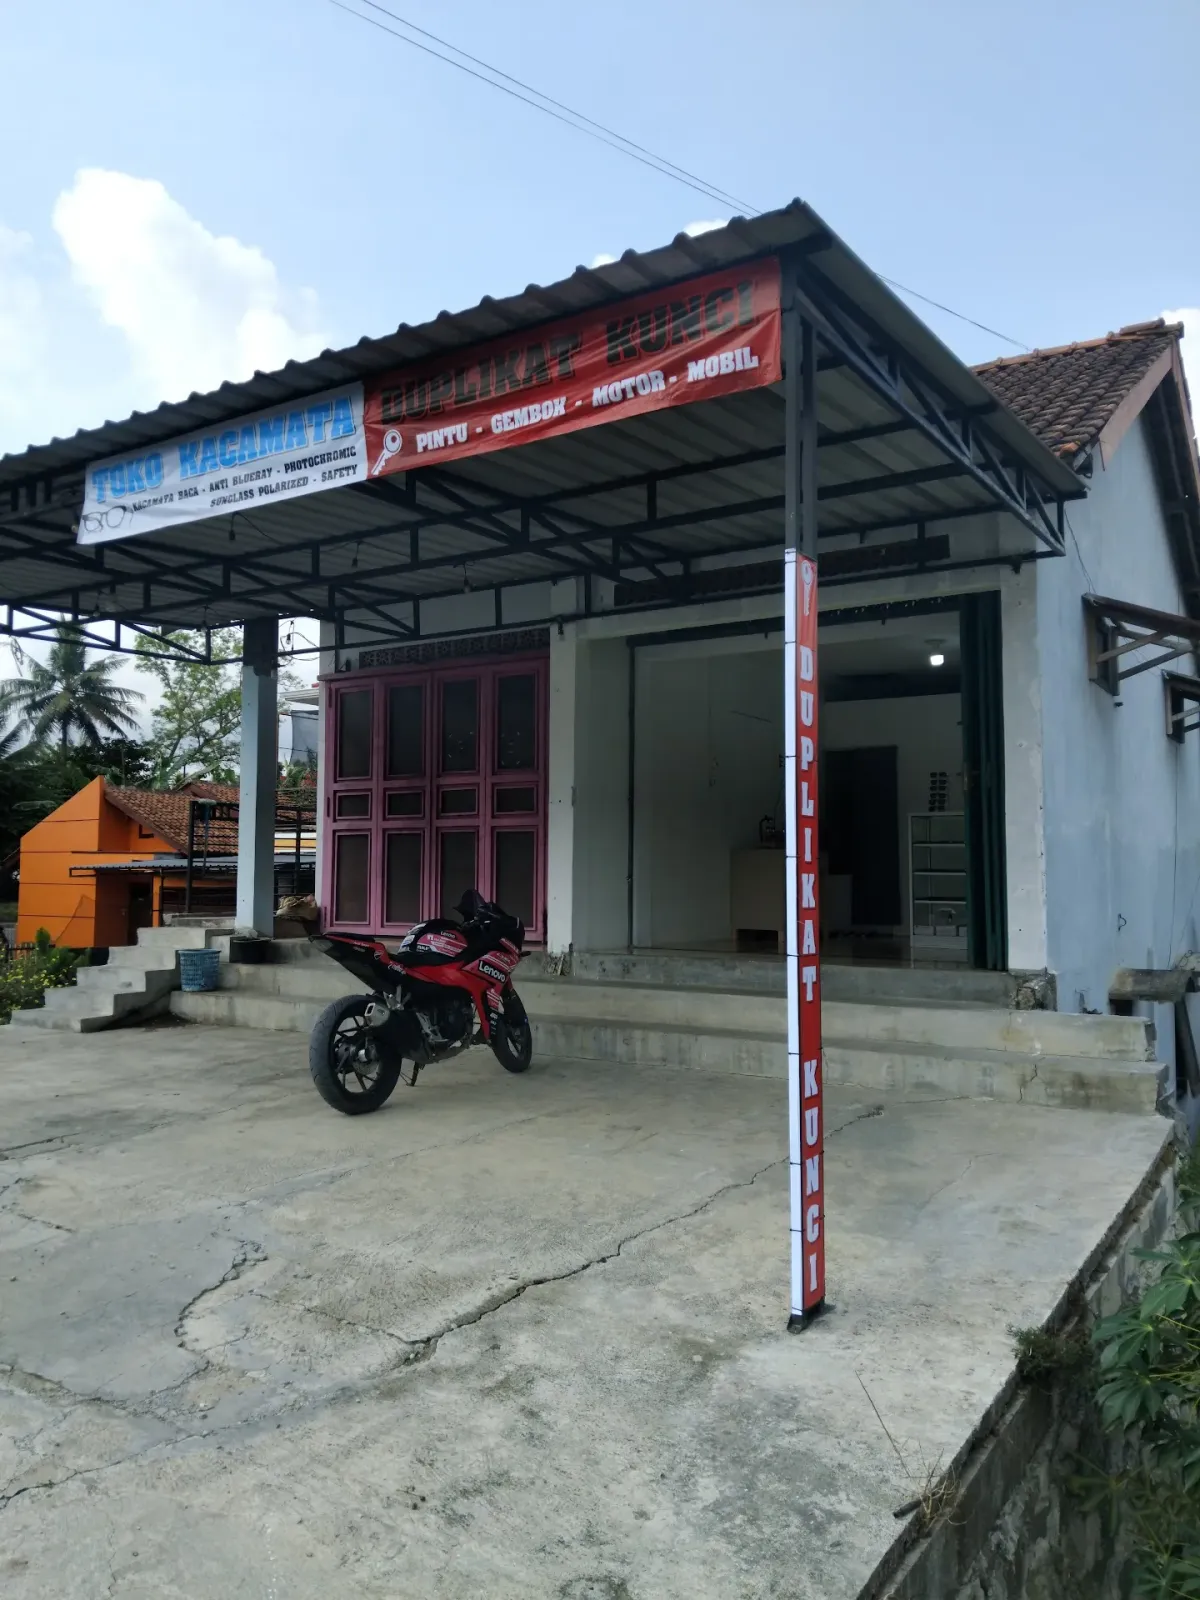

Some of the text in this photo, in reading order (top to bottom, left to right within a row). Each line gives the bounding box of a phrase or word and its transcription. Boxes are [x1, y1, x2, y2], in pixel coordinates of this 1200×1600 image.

[381, 280, 756, 423] DUPLIKAT KUNCI
[415, 422, 468, 453] PINTU
[592, 370, 666, 407] MOTOR
[687, 346, 759, 383] MOBIL
[91, 396, 356, 504] TOKO KACAMATA
[178, 486, 200, 502] BACA
[209, 477, 229, 493] ANTI
[232, 467, 273, 488] BLUERAY
[284, 445, 357, 474] PHOTOCHROMIC
[210, 488, 255, 508] SUNGLASS
[258, 475, 309, 497] POLARIZED
[321, 464, 358, 484] SAFETY
[800, 645, 817, 1002] DUPLIKAT
[478, 960, 506, 983] Lenovo
[803, 1058, 821, 1293] KUNCI
